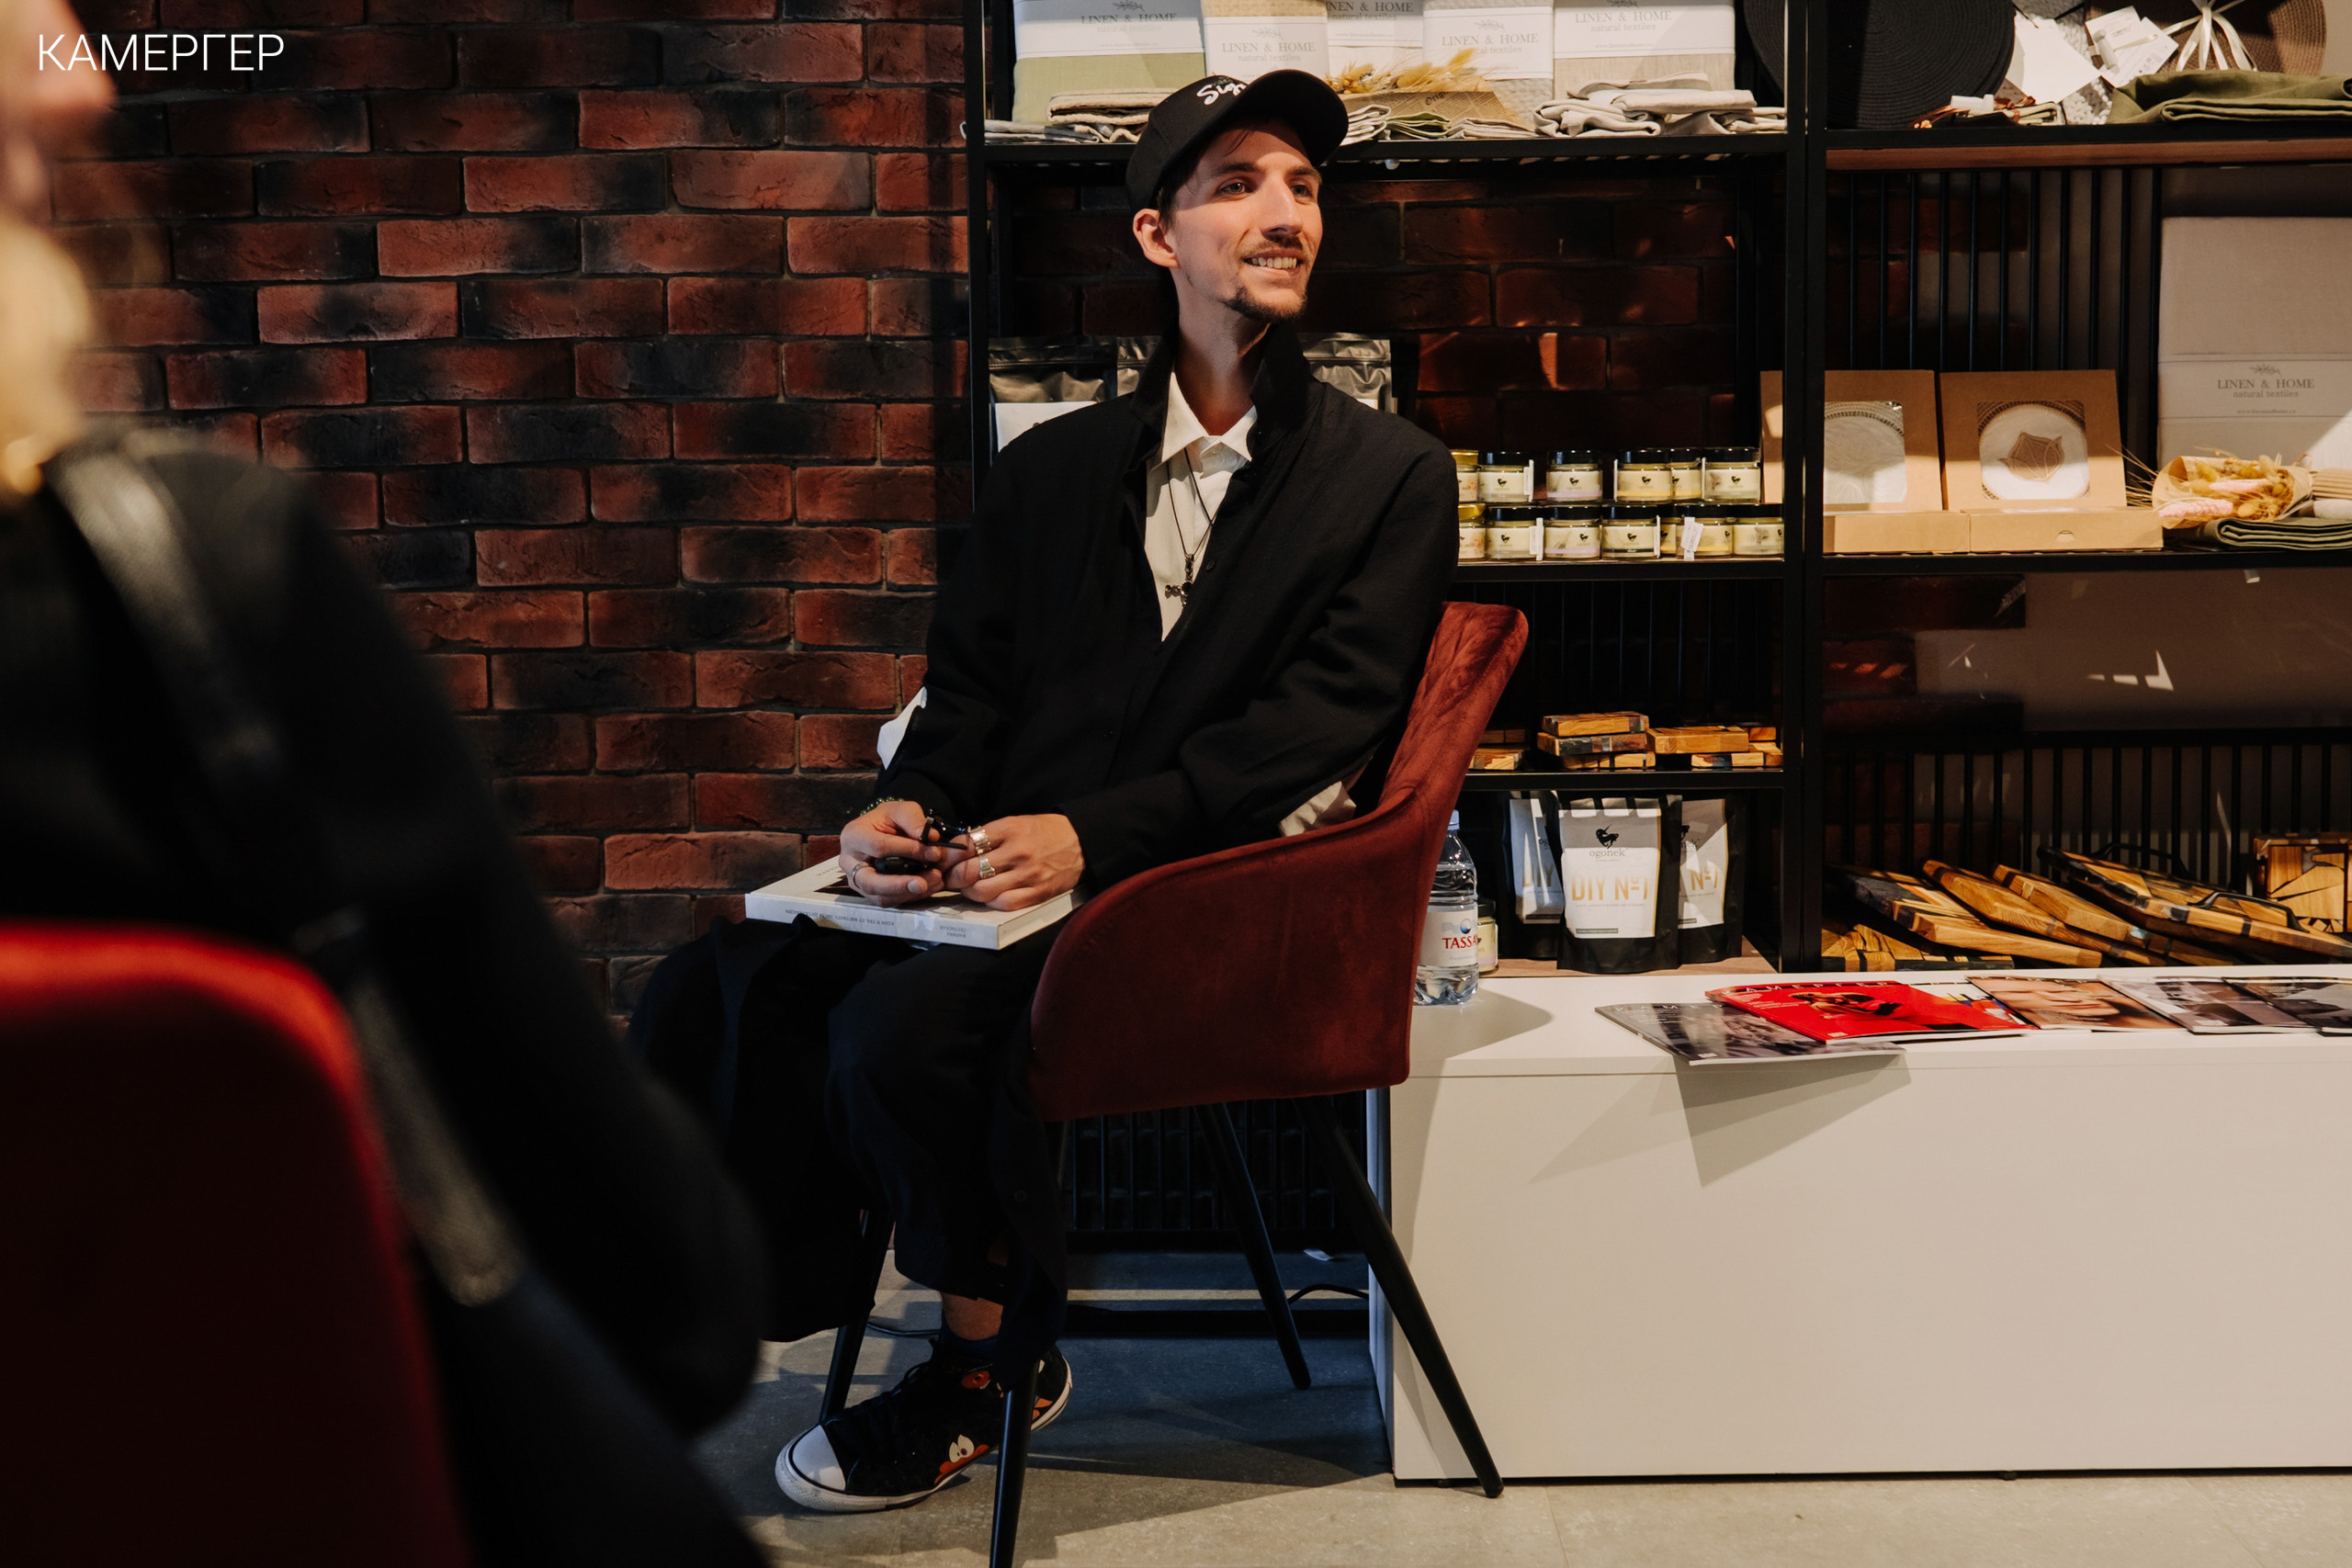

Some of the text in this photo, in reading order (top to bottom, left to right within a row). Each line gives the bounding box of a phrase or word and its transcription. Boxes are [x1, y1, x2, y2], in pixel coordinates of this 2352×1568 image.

[1326, 2, 1413, 12] INEN & HOME
[1081, 13, 1177, 24] LINEN & HOME
[1575, 10, 1672, 23] LINEN & HOME
[1442, 33, 1540, 46] LINEN & HOME
[1222, 42, 1316, 52] LINEN & HOME
[1238, 53, 1301, 62] natural textiles
[2217, 378, 2315, 389] LINEN & HOME
[2233, 389, 2299, 398] natural textiles
[1589, 847, 1625, 858] ogonek
[1571, 874, 1606, 901] DIY
[1442, 934, 1478, 950] TASSA
